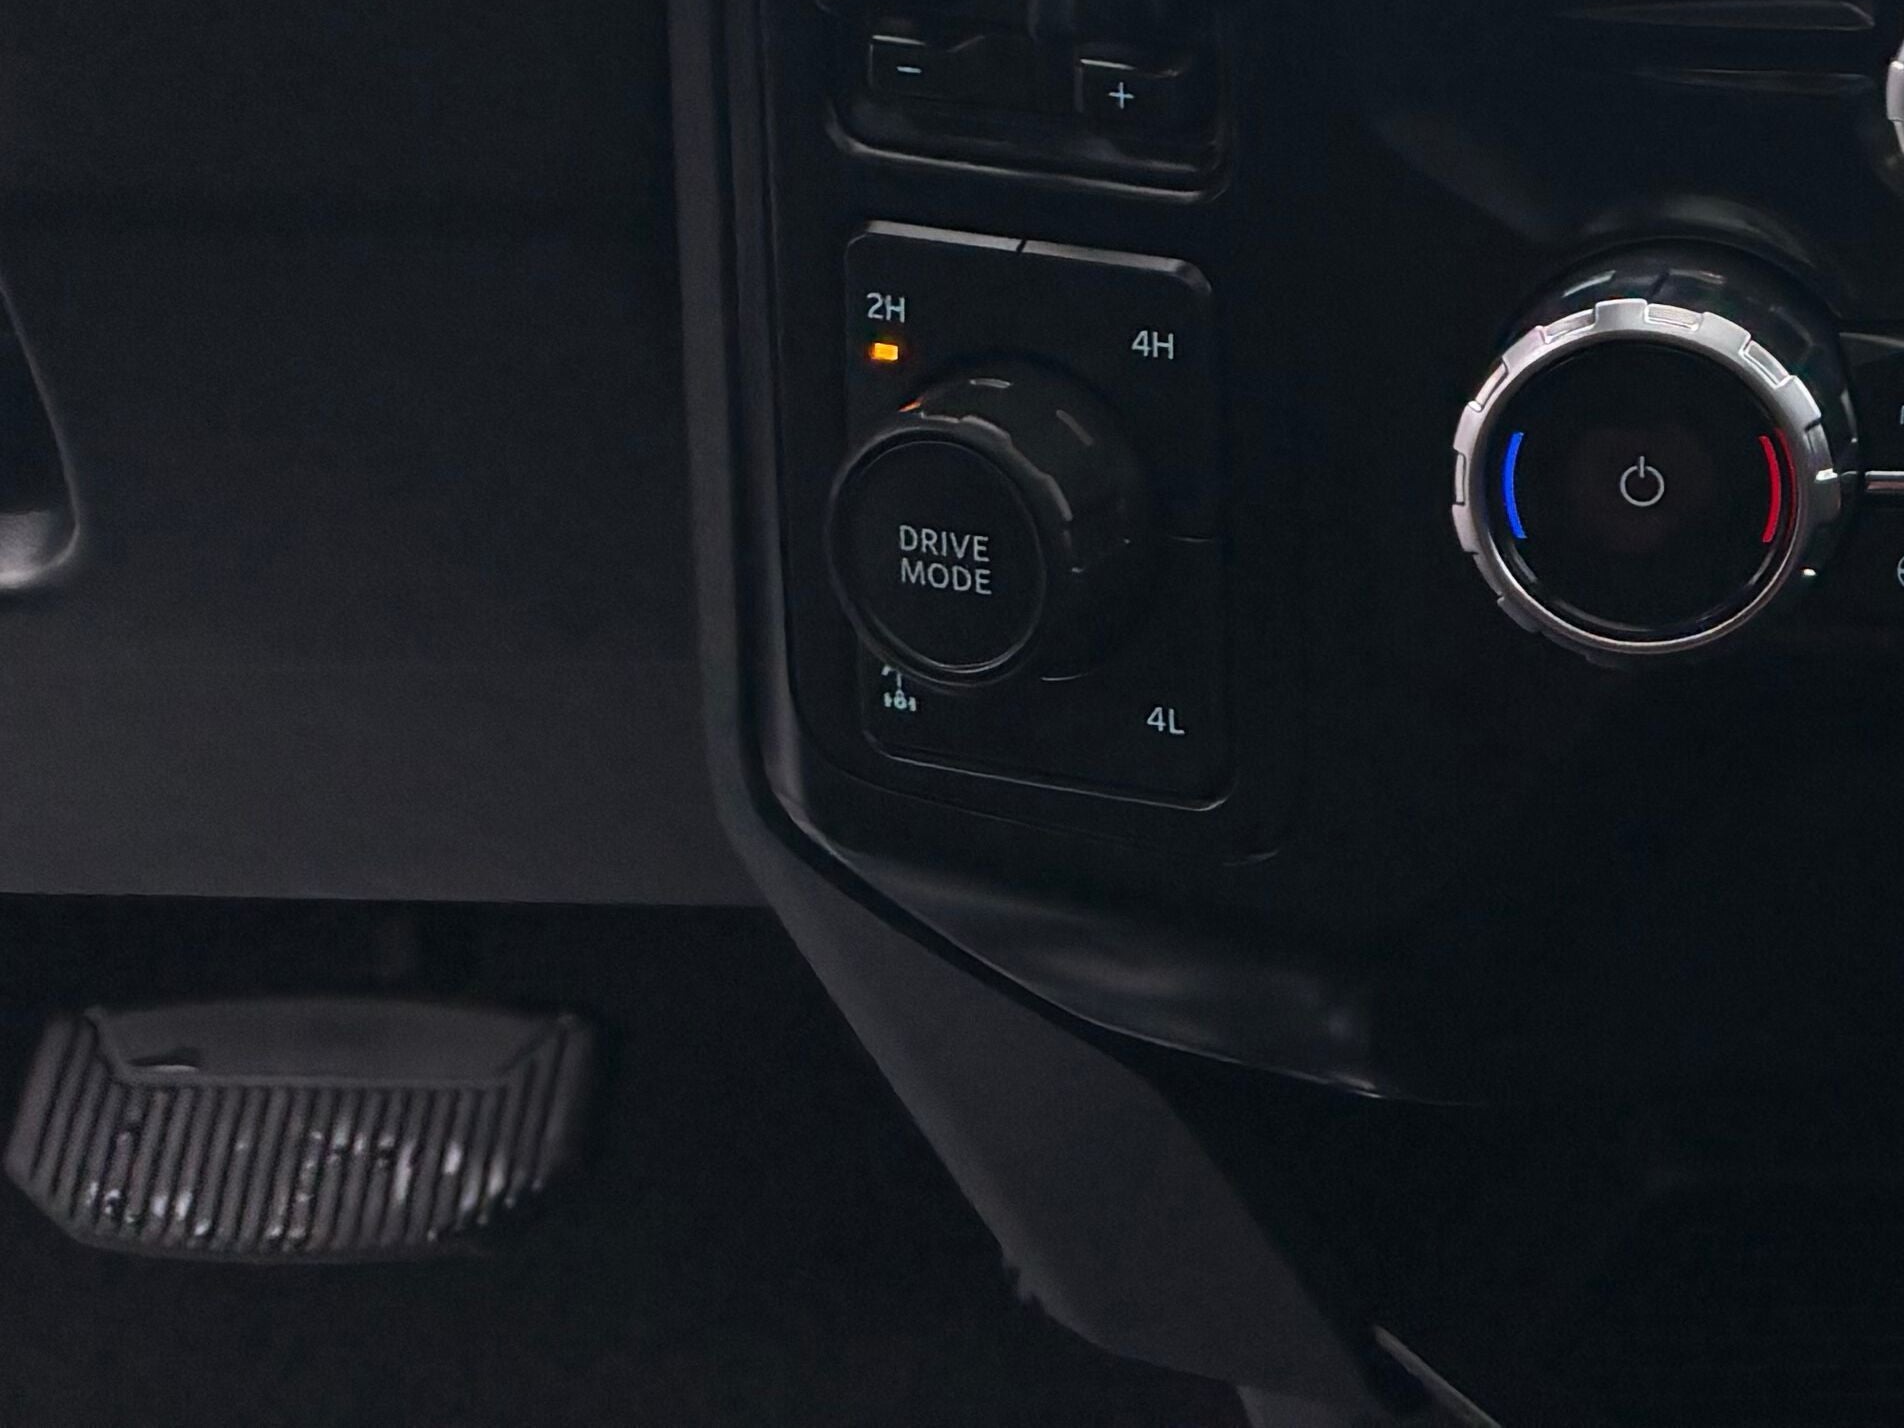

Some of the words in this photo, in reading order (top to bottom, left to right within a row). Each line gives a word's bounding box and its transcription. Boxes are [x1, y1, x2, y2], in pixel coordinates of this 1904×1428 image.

[866, 292, 906, 323] 2H
[1131, 330, 1175, 360] 4H
[899, 525, 989, 562] DRIVE
[901, 557, 992, 595] MODE
[1147, 706, 1185, 736] 4L
